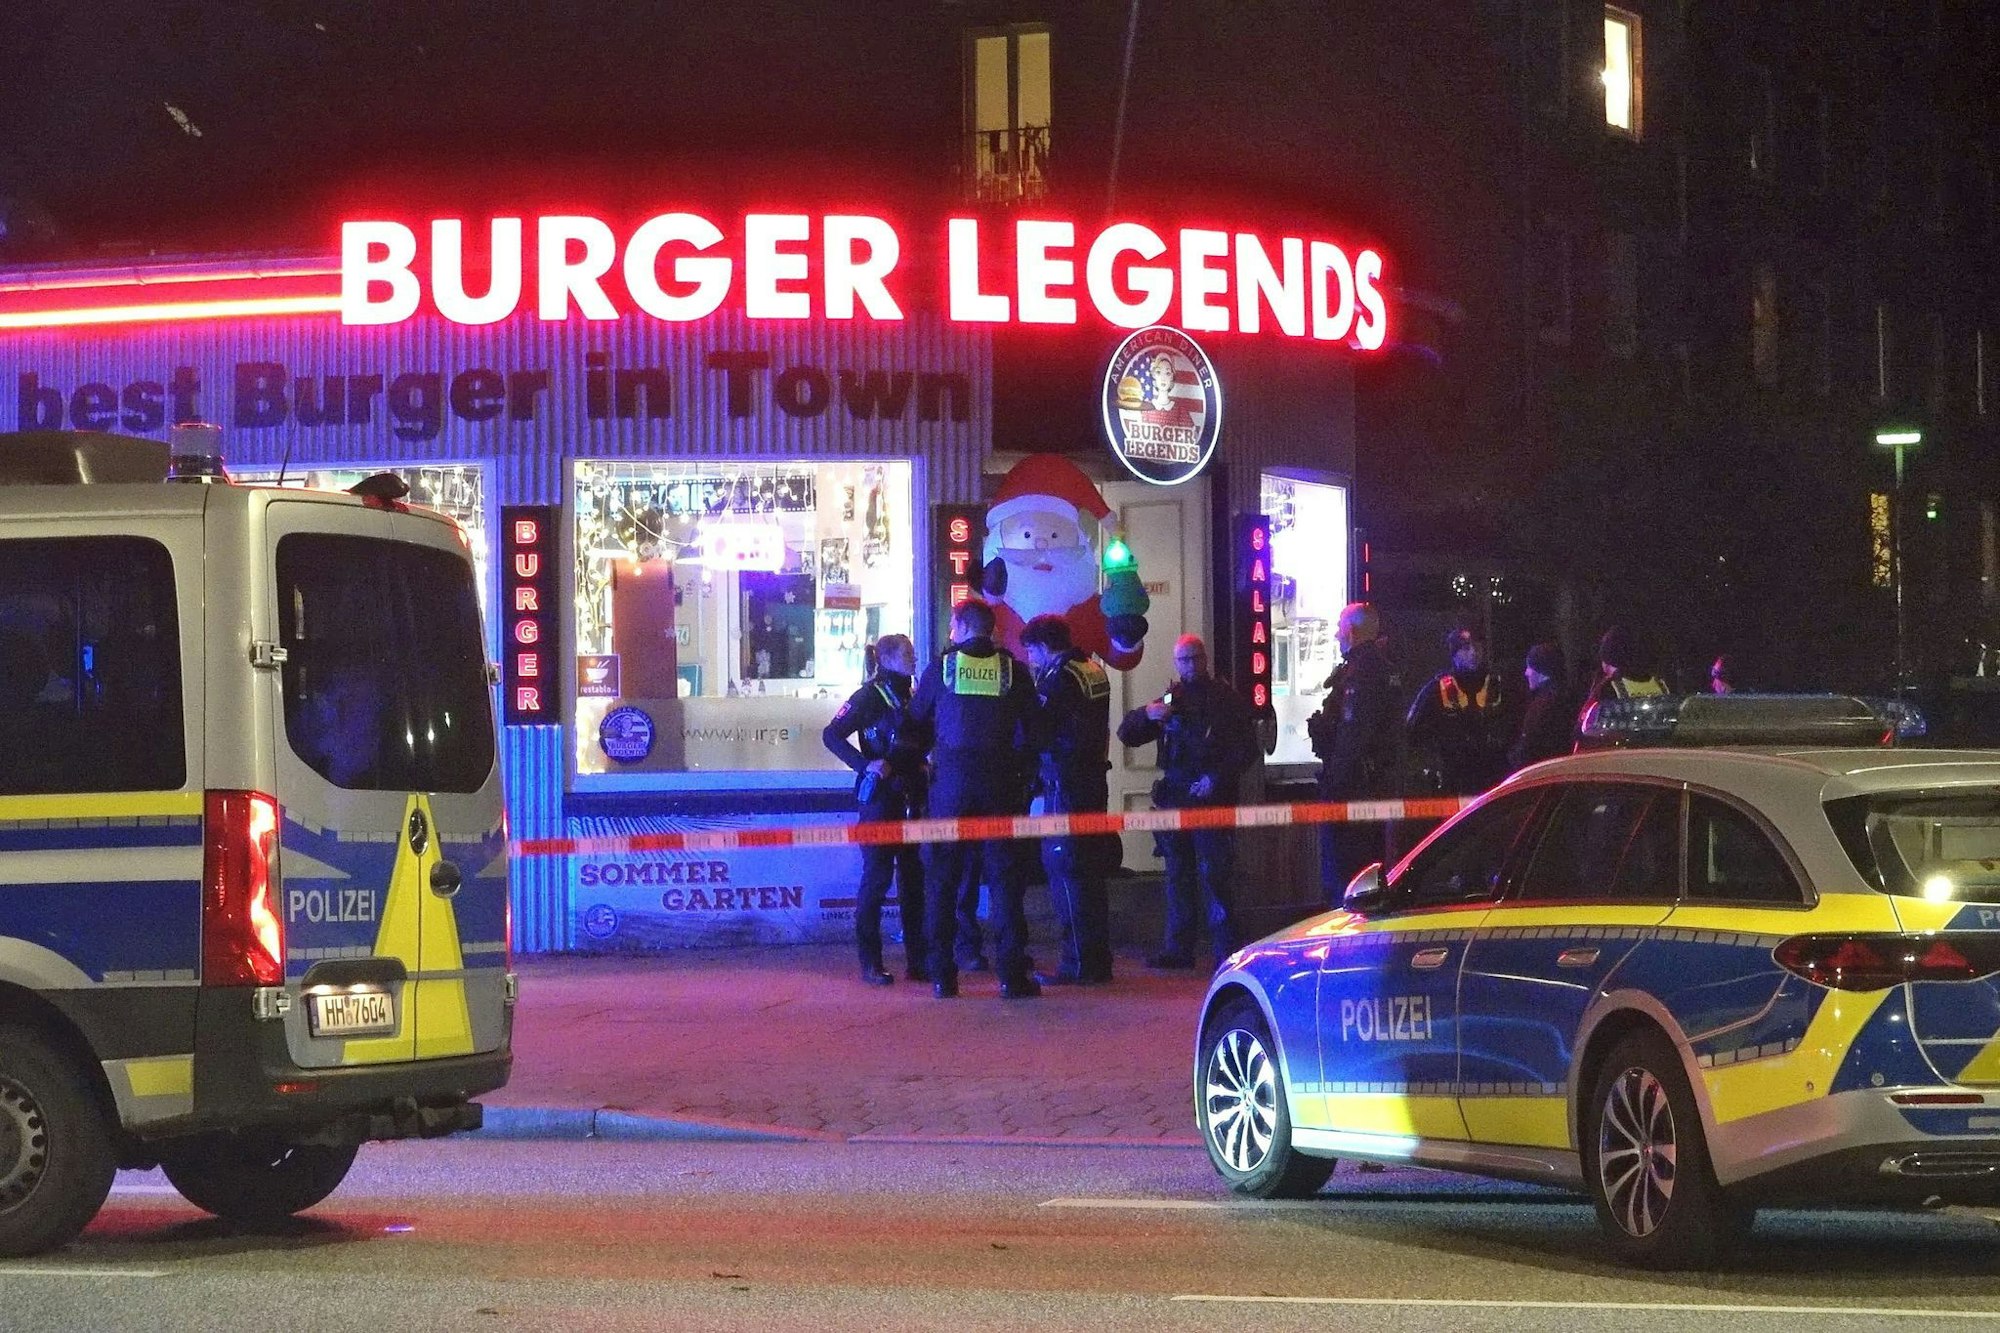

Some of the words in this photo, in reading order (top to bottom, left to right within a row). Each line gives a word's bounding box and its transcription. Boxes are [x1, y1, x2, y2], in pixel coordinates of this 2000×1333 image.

[341, 213, 903, 326] BURGER
[948, 218, 1386, 351] LEGENDS
[1111, 331, 1173, 383] AMERICAN
[1180, 338, 1212, 389] DINER
[18, 366, 200, 433] best
[235, 361, 549, 440] Burger
[586, 352, 670, 419] in
[708, 349, 968, 422] Town
[1130, 424, 1196, 445] BURGER
[1125, 441, 1200, 462] LEGENDS
[515, 520, 540, 711] BURGER
[1252, 528, 1267, 706] SALADS
[959, 667, 999, 681] POLIZEI
[580, 861, 730, 887] SOMMER
[289, 890, 376, 922] POLIZEI
[662, 886, 804, 911] GARTEN
[325, 999, 345, 1026] HH
[352, 996, 386, 1024] 7604
[1340, 996, 1432, 1041] POLIZEI
